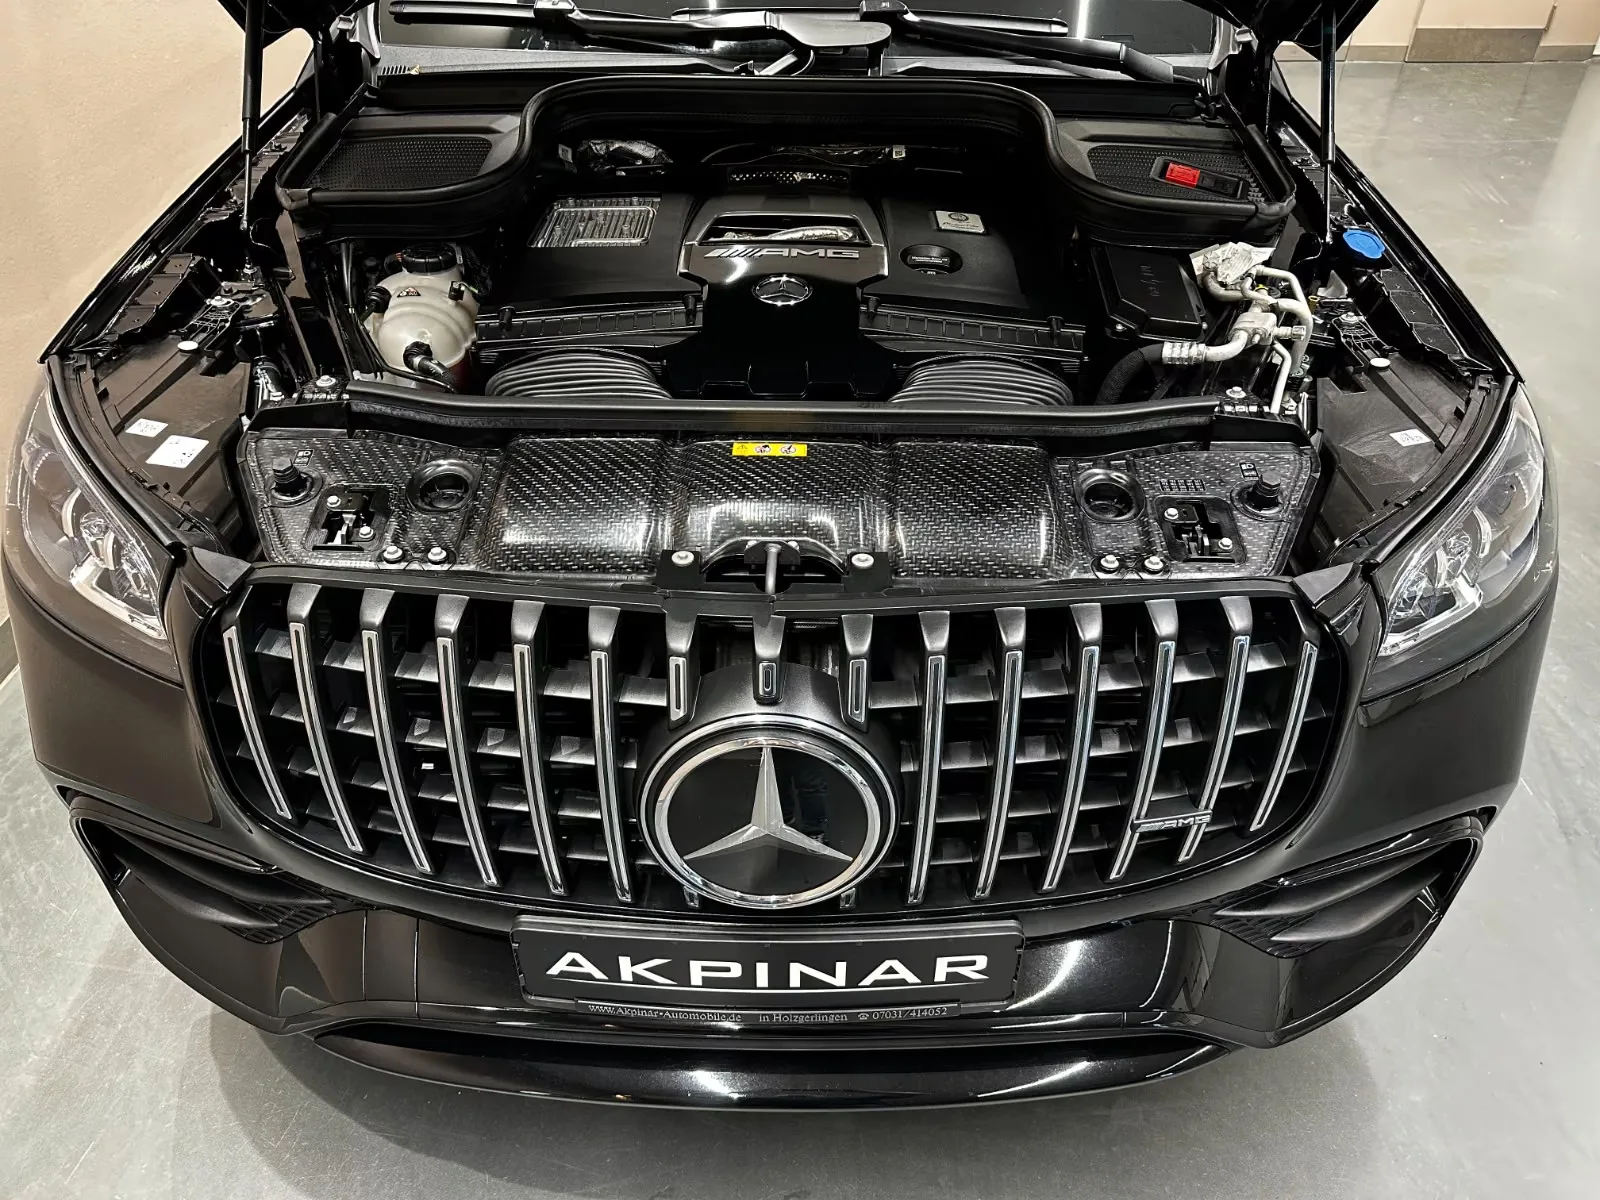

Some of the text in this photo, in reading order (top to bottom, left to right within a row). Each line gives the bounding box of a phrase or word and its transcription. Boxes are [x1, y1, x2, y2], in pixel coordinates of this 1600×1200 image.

[757, 248, 860, 258] AMG
[1161, 815, 1211, 829] AMG
[546, 951, 990, 988] AKPINAR
[588, 1004, 948, 1024] www.Akpinar-Automobile.de in Holzgerlingen 07031/414052
